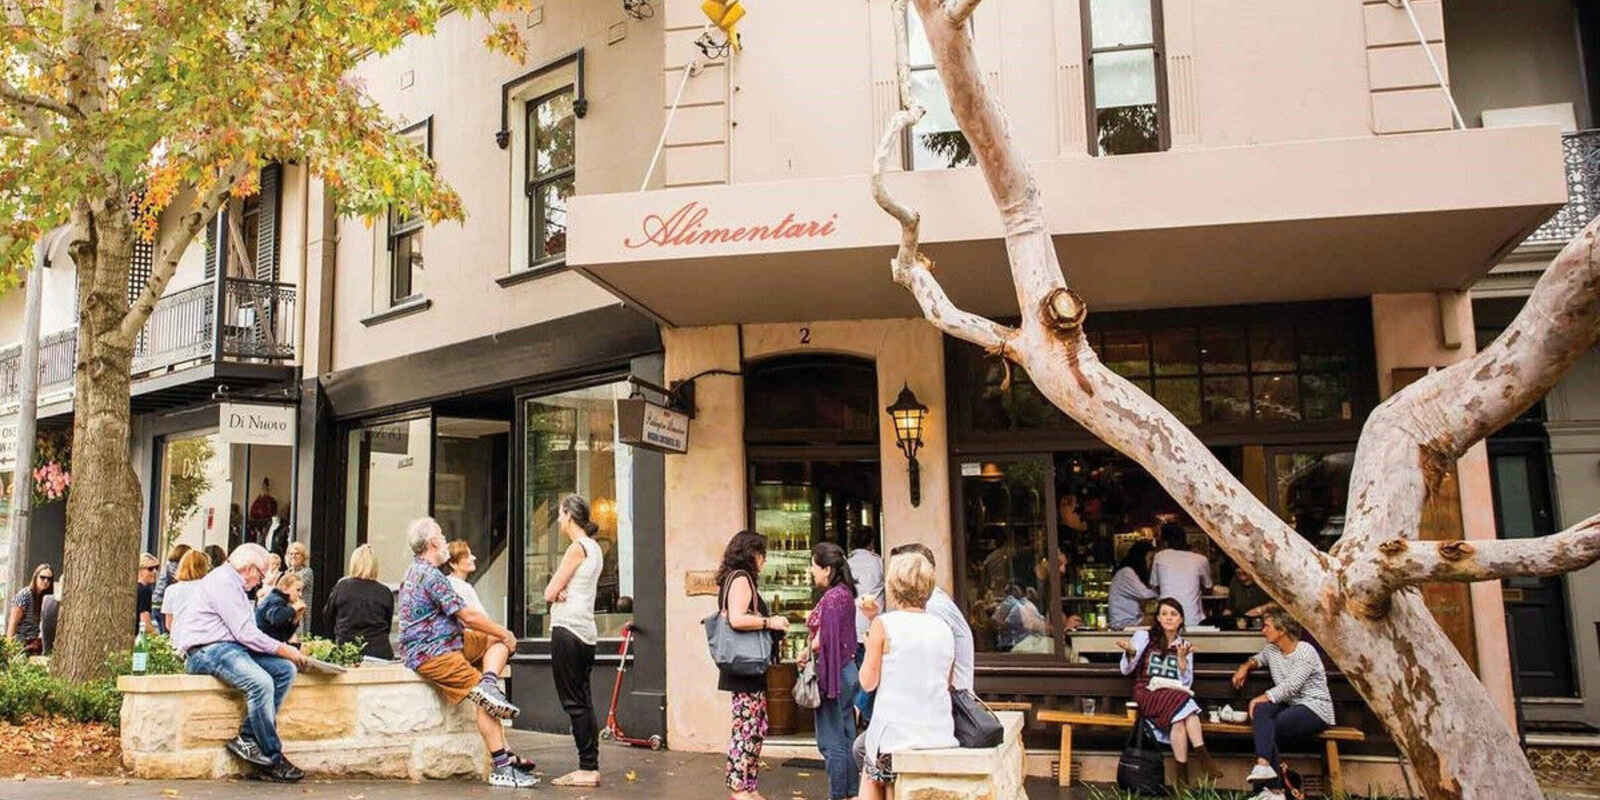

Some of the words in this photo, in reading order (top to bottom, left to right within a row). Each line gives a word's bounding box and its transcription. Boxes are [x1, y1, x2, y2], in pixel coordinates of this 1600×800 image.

[624, 201, 838, 249] Alimentari
[799, 328, 811, 344] 2
[229, 413, 246, 429] Di
[248, 415, 288, 431] Nuovo
